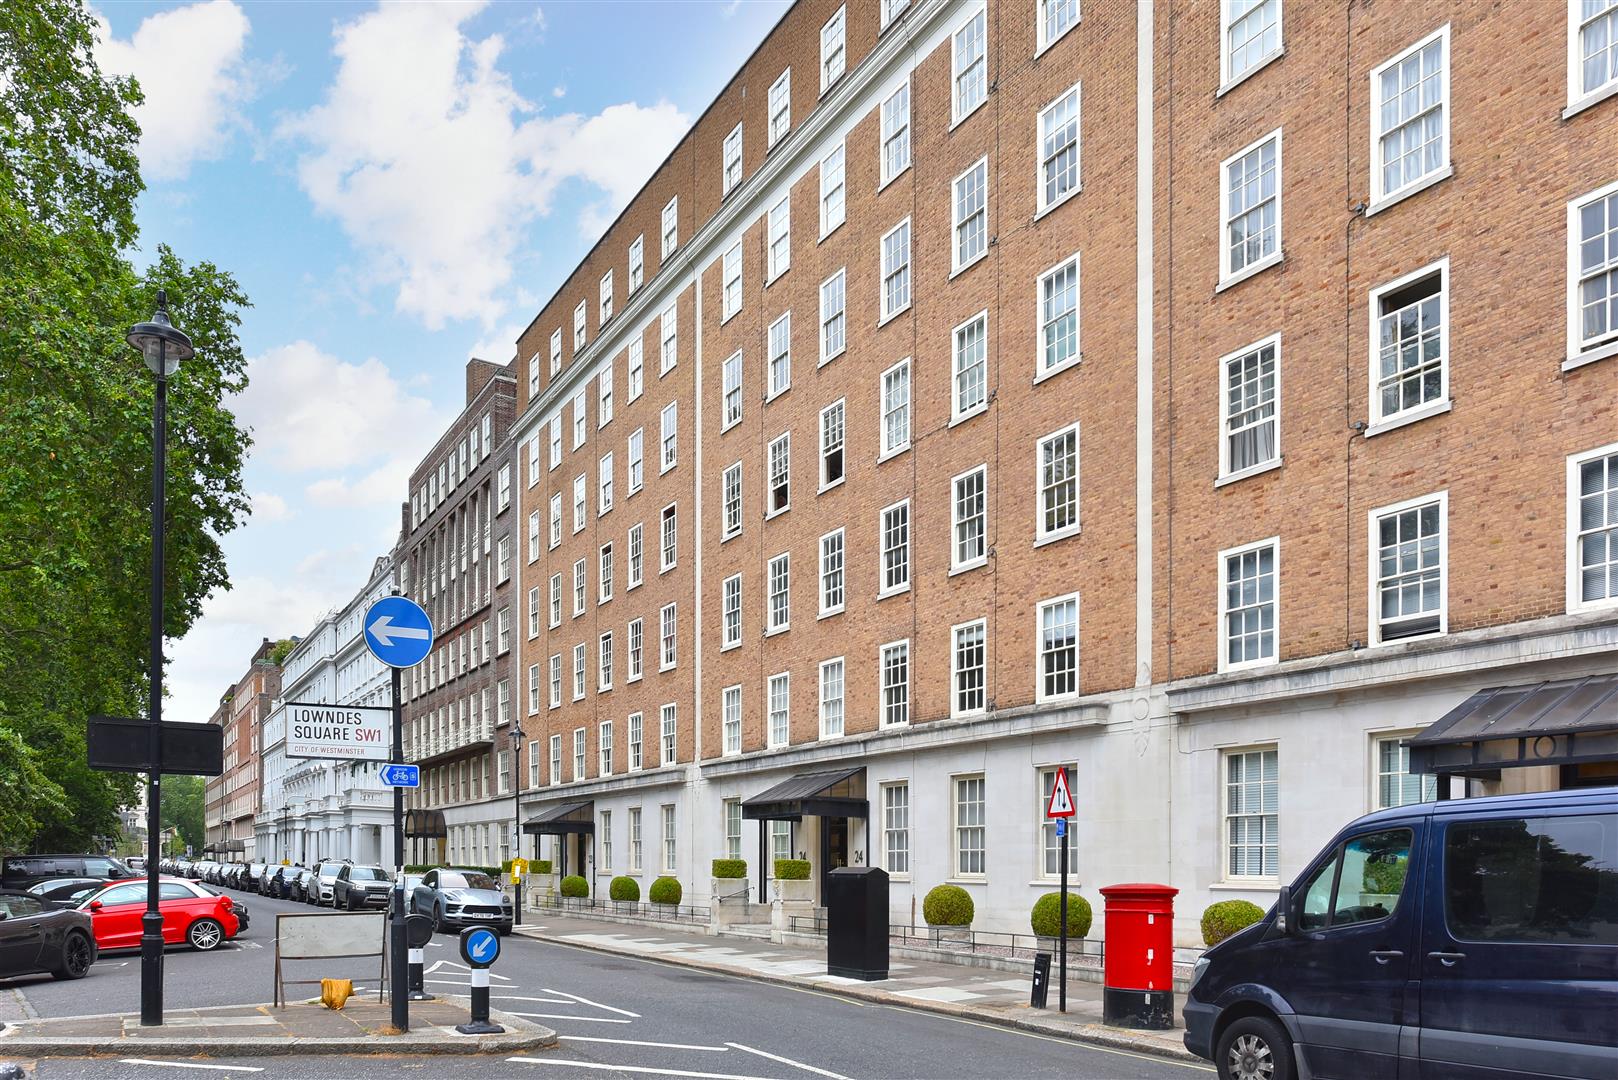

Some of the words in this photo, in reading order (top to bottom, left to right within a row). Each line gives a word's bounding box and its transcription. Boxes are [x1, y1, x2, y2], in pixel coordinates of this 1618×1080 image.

[294, 709, 362, 725] LOWNDES
[294, 725, 350, 740] SQUARE
[355, 728, 381, 742] SW1
[294, 745, 309, 753] CITY
[320, 747, 365, 755] WESTMINSTER
[854, 850, 864, 864] 24
